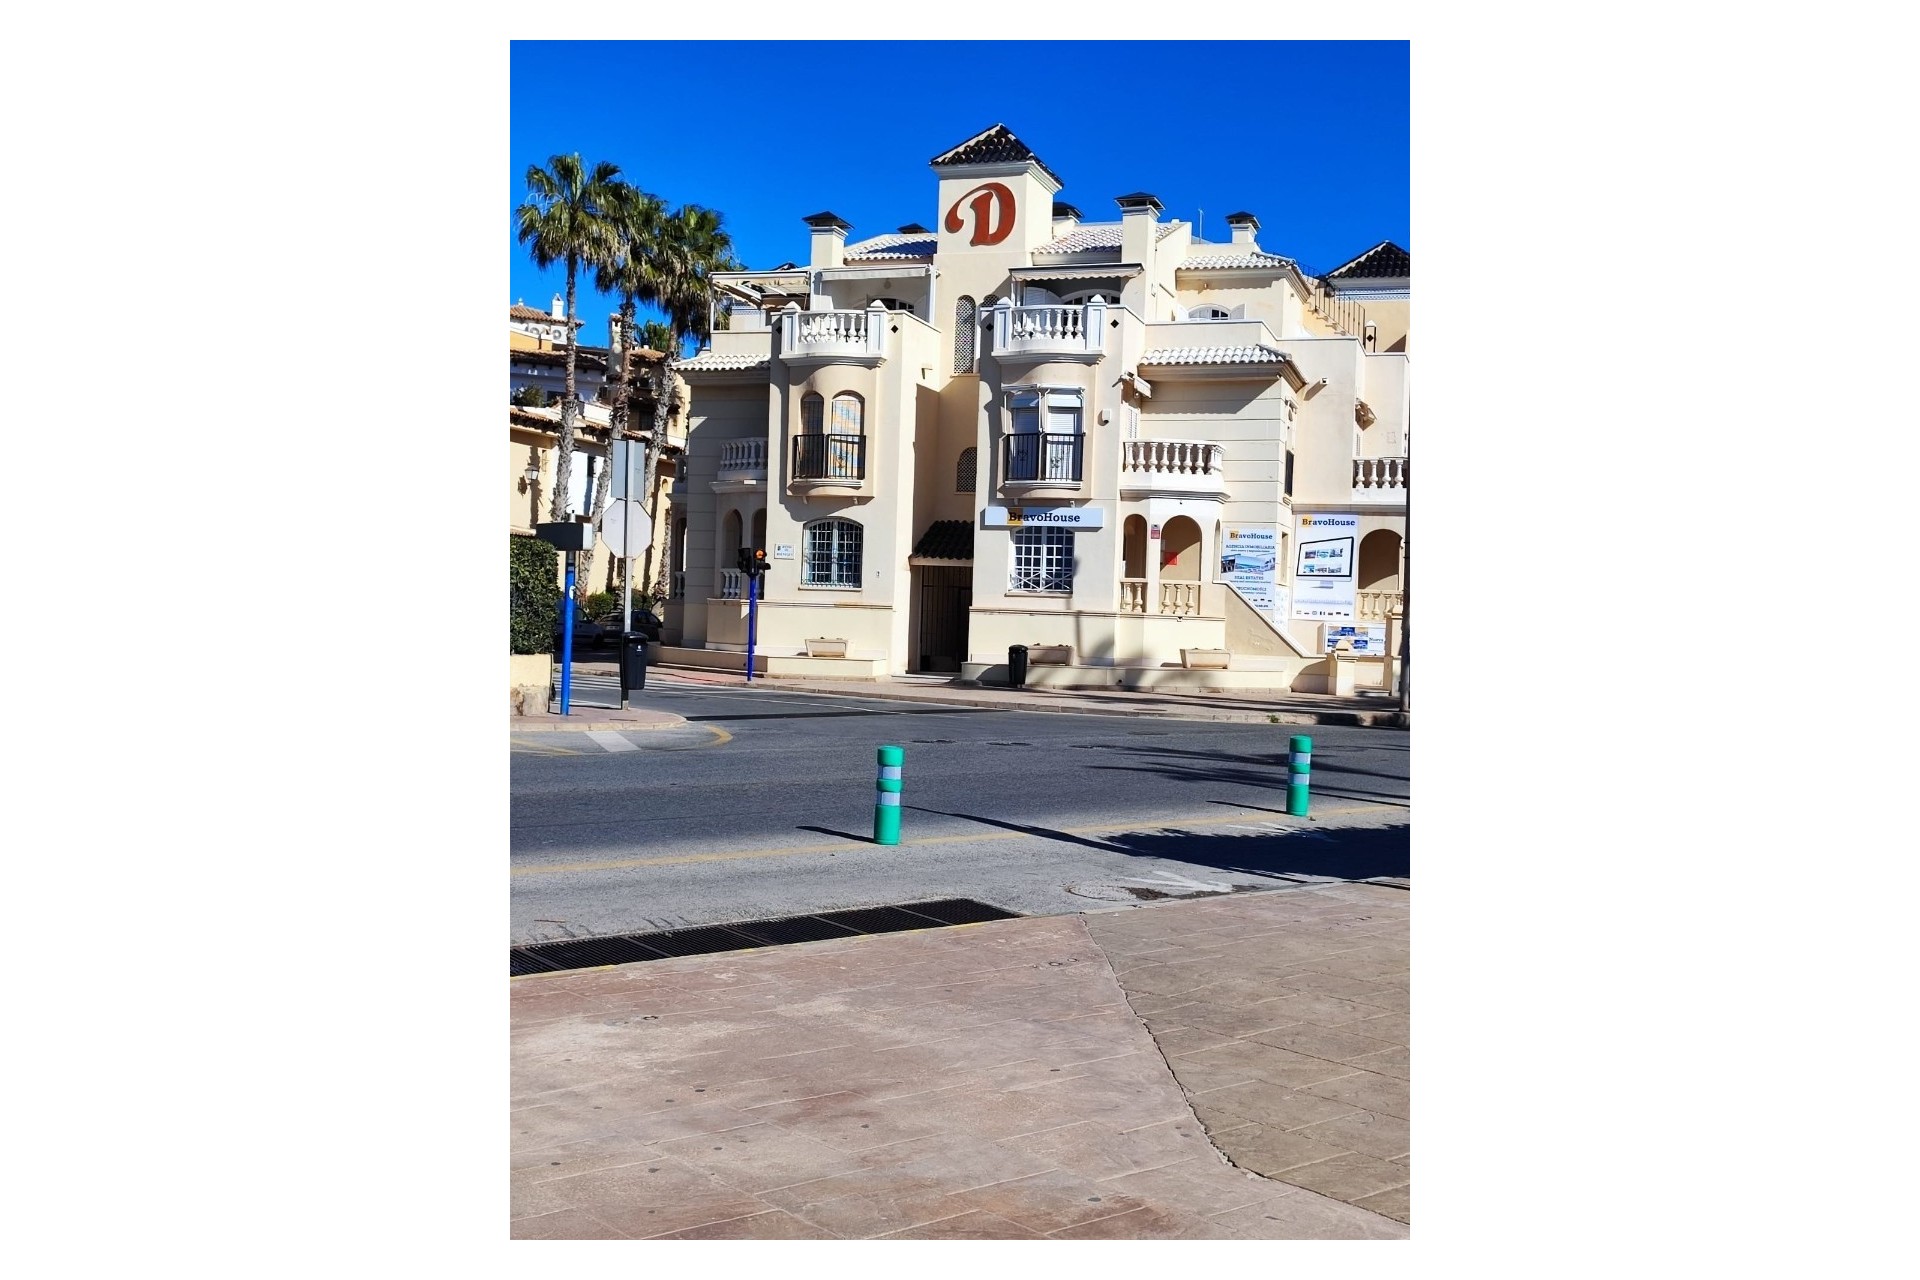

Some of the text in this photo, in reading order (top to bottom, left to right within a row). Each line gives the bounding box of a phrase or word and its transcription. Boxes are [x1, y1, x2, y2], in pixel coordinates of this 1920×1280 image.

[944, 182, 1016, 247] D
[1009, 512, 1081, 522] BravoHouse
[1302, 518, 1356, 526] BravoHouse
[1230, 532, 1273, 540] BravoHouse
